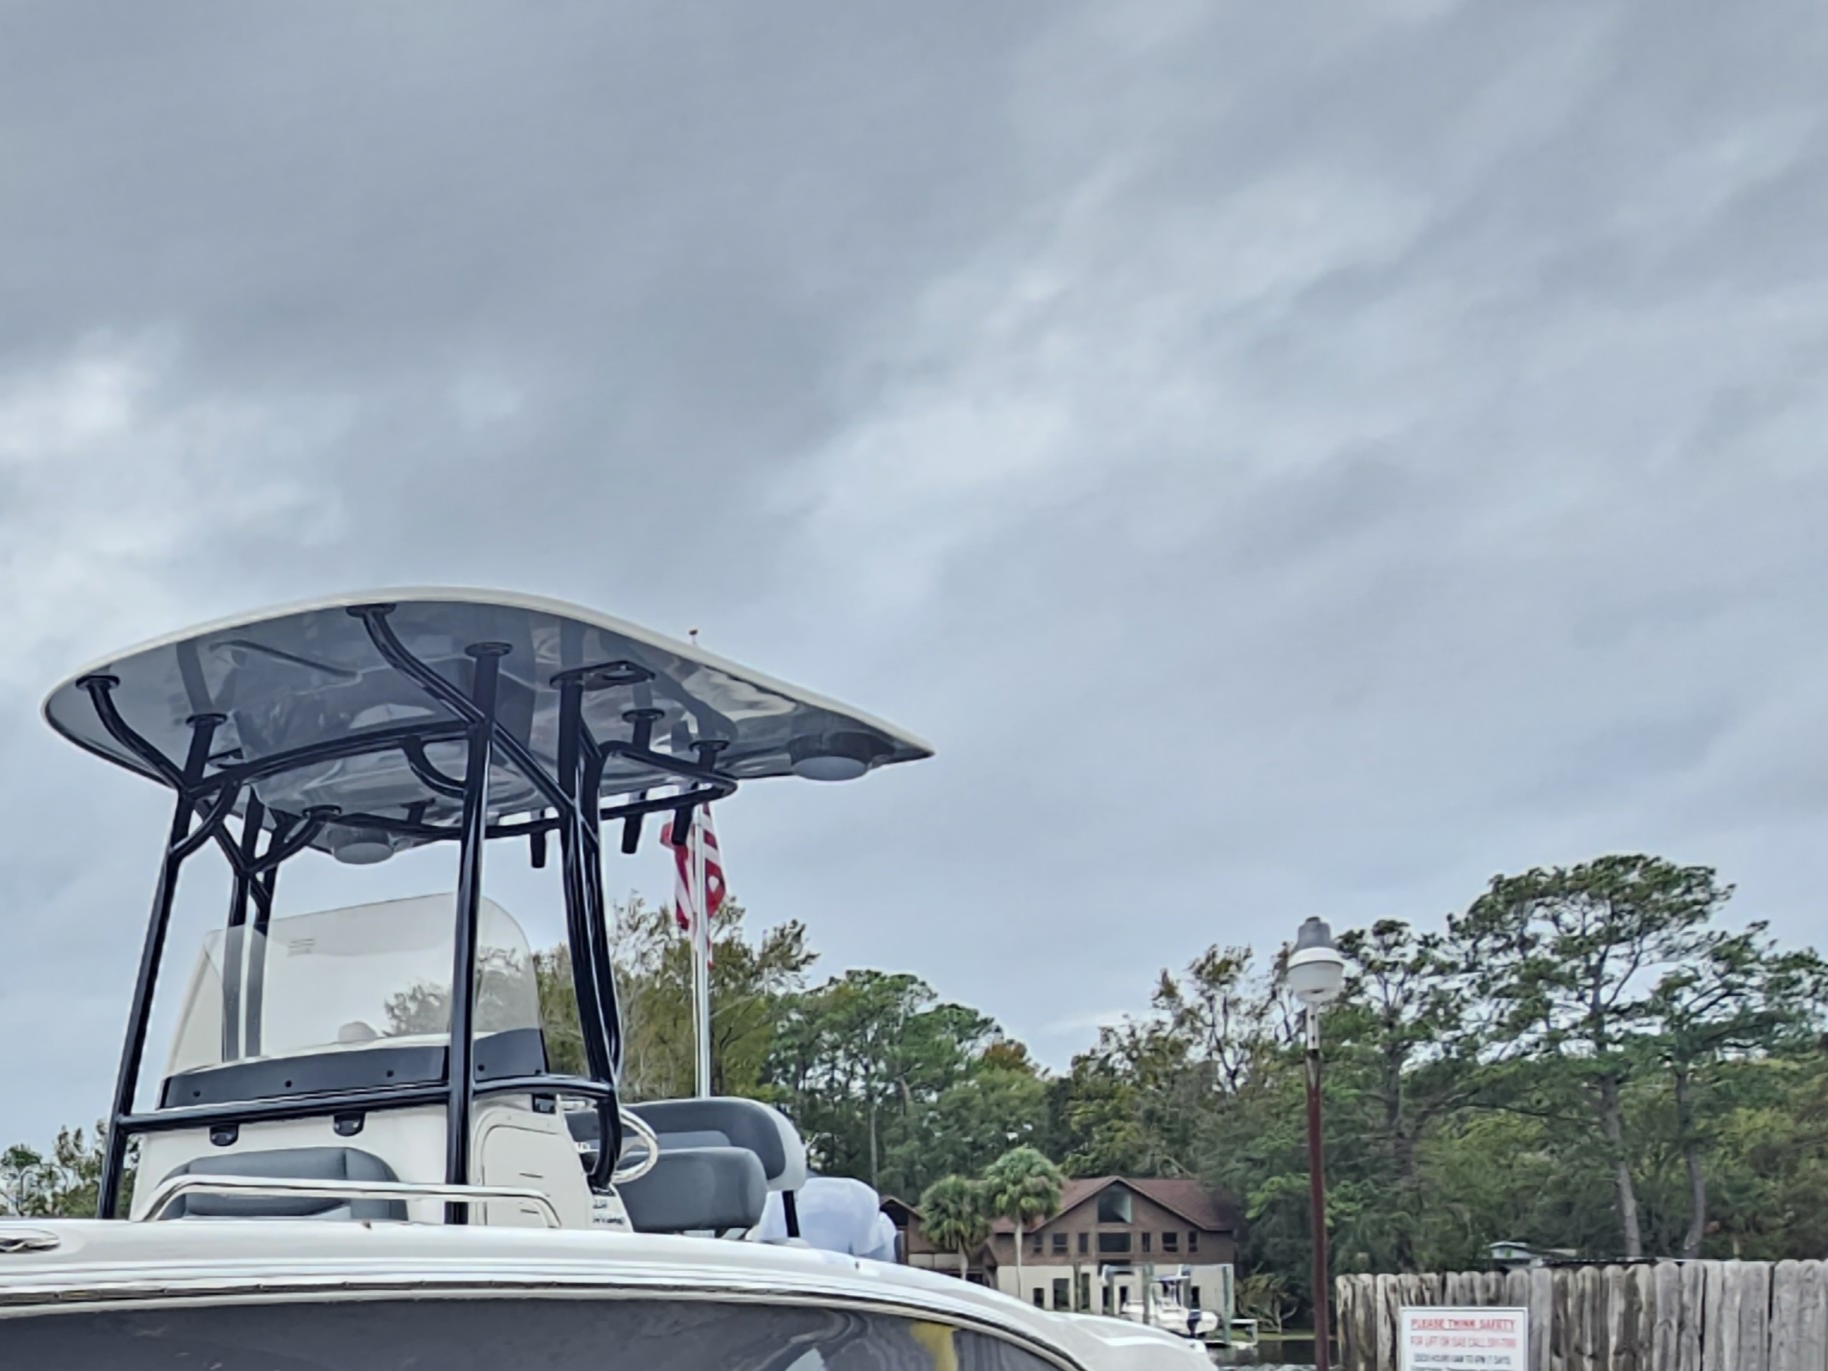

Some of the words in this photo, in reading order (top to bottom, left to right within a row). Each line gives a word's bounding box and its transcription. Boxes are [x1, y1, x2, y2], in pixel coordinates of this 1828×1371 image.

[1410, 1318, 1444, 1330] PLEASE
[1448, 1319, 1476, 1330] THINK
[1479, 1319, 1516, 1331] SAFETY
